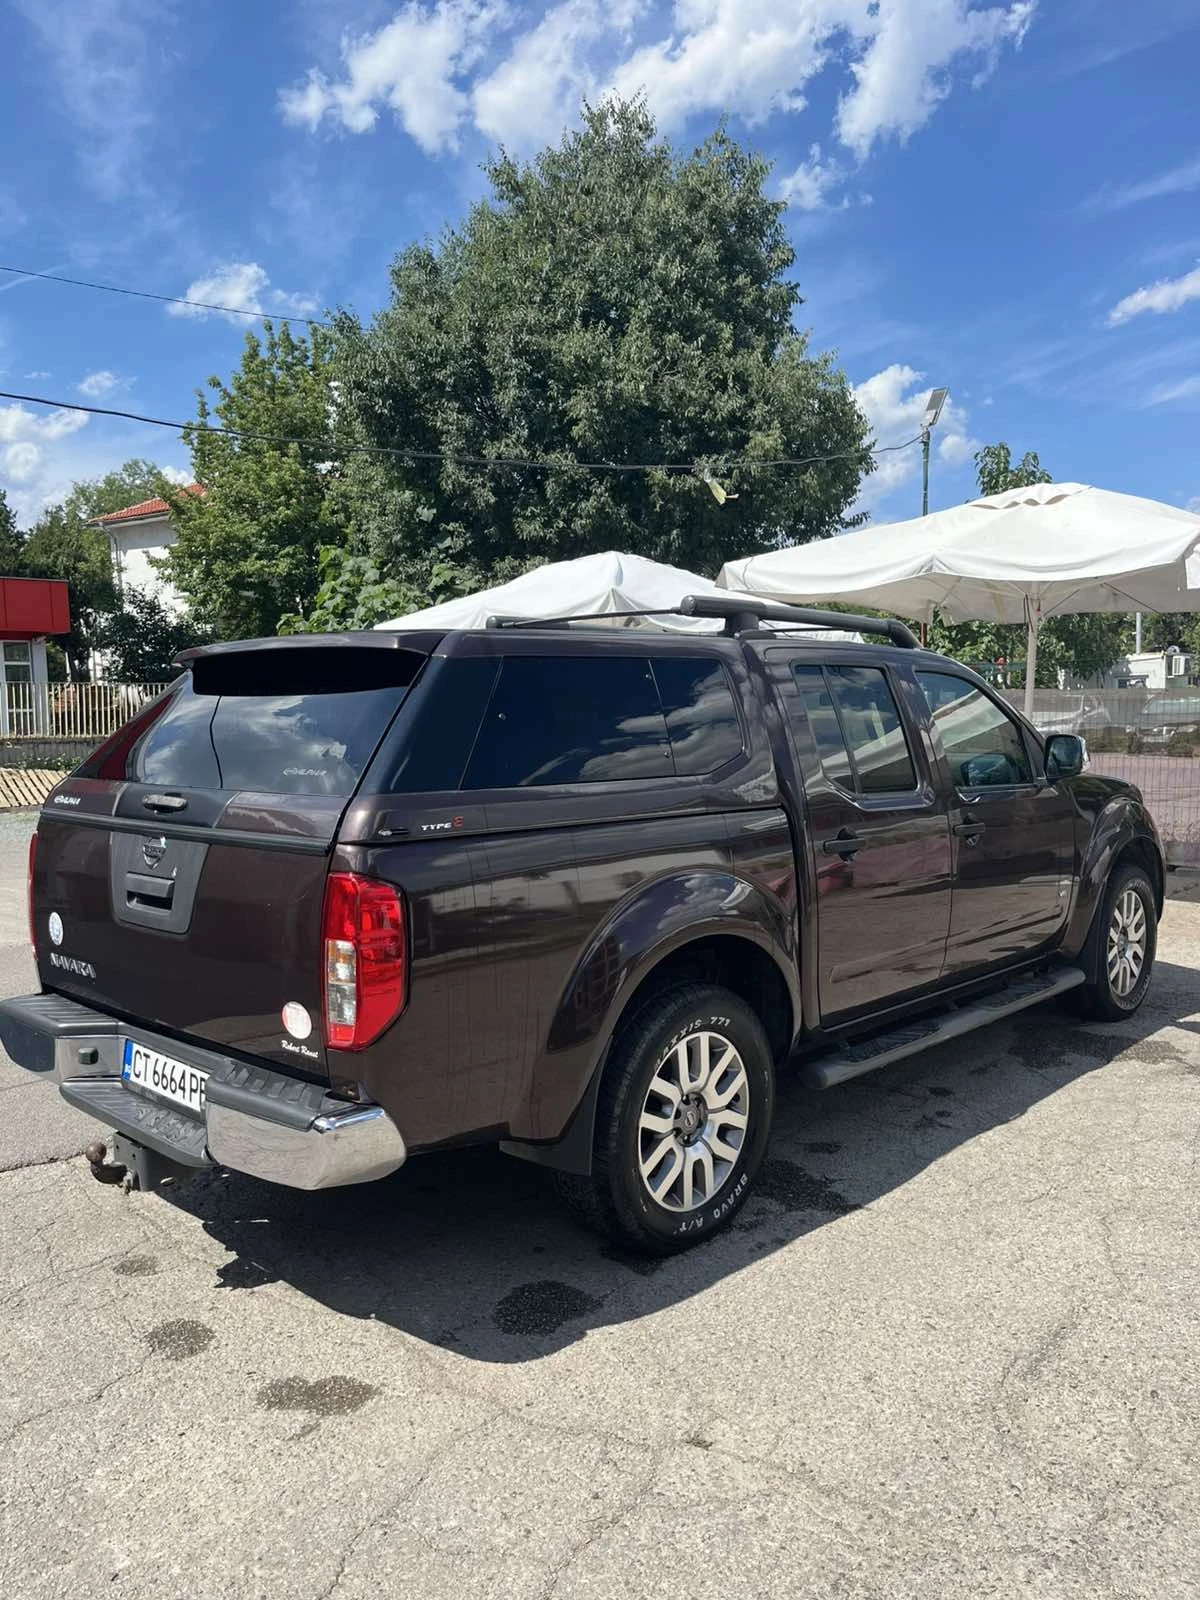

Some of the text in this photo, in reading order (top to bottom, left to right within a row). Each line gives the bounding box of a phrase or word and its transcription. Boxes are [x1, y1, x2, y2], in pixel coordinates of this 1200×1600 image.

[421, 822, 452, 831] TYPE
[50, 952, 97, 979] NAVARA
[713, 1173, 748, 1219] BRAVO
